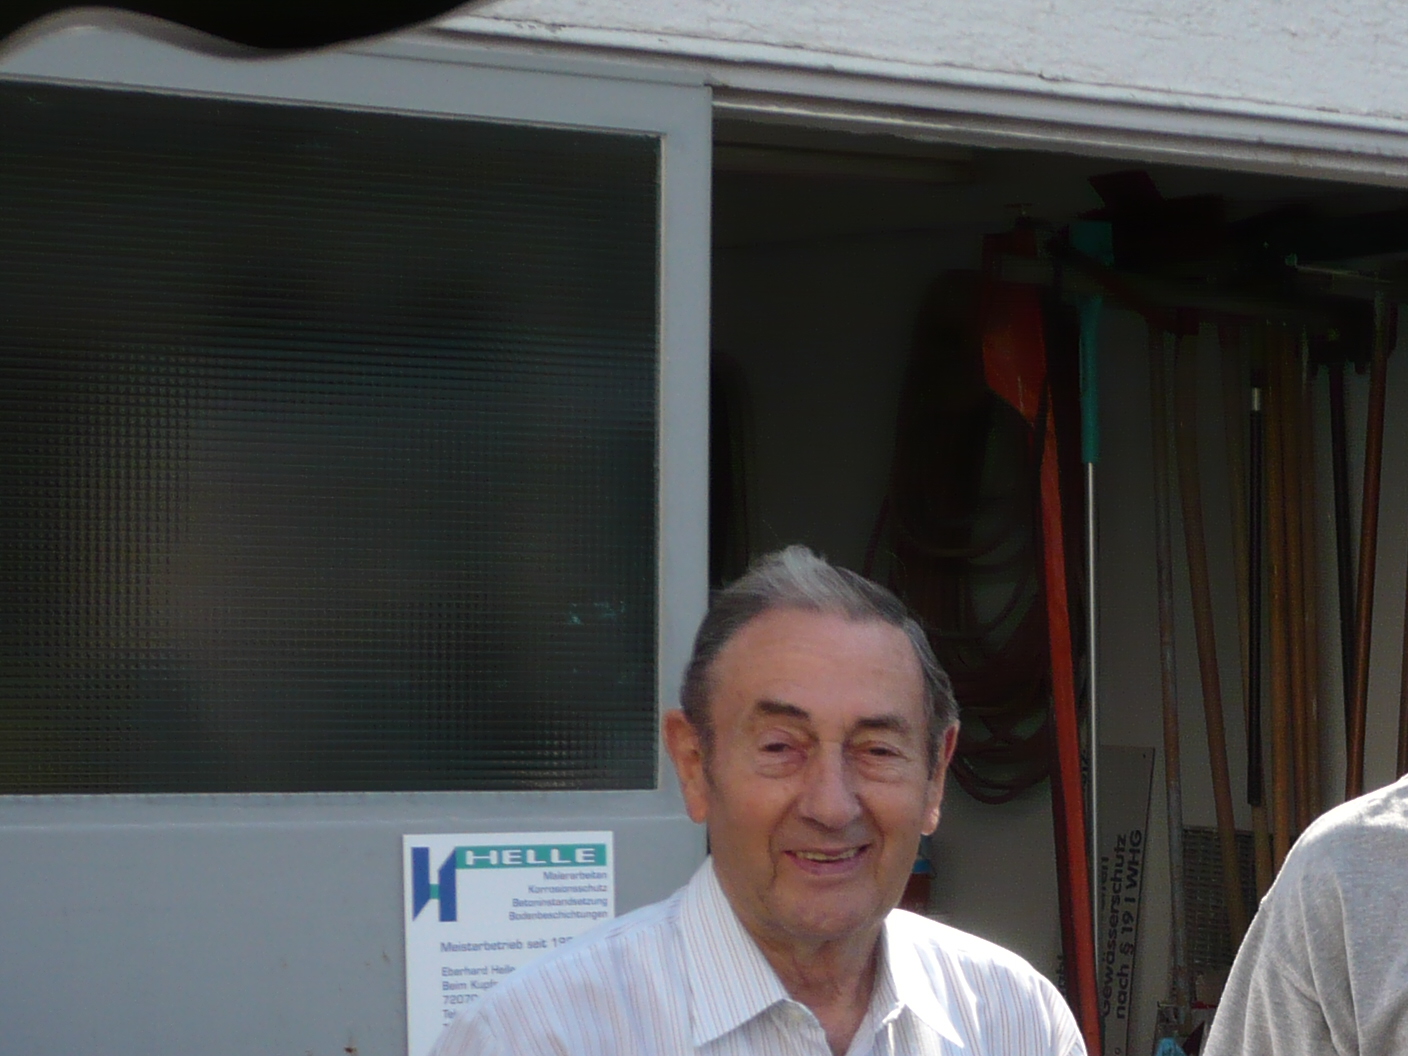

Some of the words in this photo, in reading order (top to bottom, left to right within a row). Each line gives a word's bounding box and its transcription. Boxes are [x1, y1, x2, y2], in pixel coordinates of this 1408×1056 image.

[465, 848, 595, 865] HELLE
[1126, 830, 1142, 889] WHG
[543, 871, 607, 880] Malerarbeiten
[528, 884, 607, 893] Korrosionsschutz
[512, 898, 608, 907] Betoninstandsetzung
[509, 911, 608, 920] Bodenbeschichtungen
[1120, 911, 1135, 934] 19
[440, 941, 523, 952] Meisterbetrieb
[526, 938, 548, 950] seit
[551, 936, 574, 949] 19
[441, 966, 488, 977] Eberhard
[442, 980, 467, 991] Beim
[1115, 964, 1129, 1018] nach
